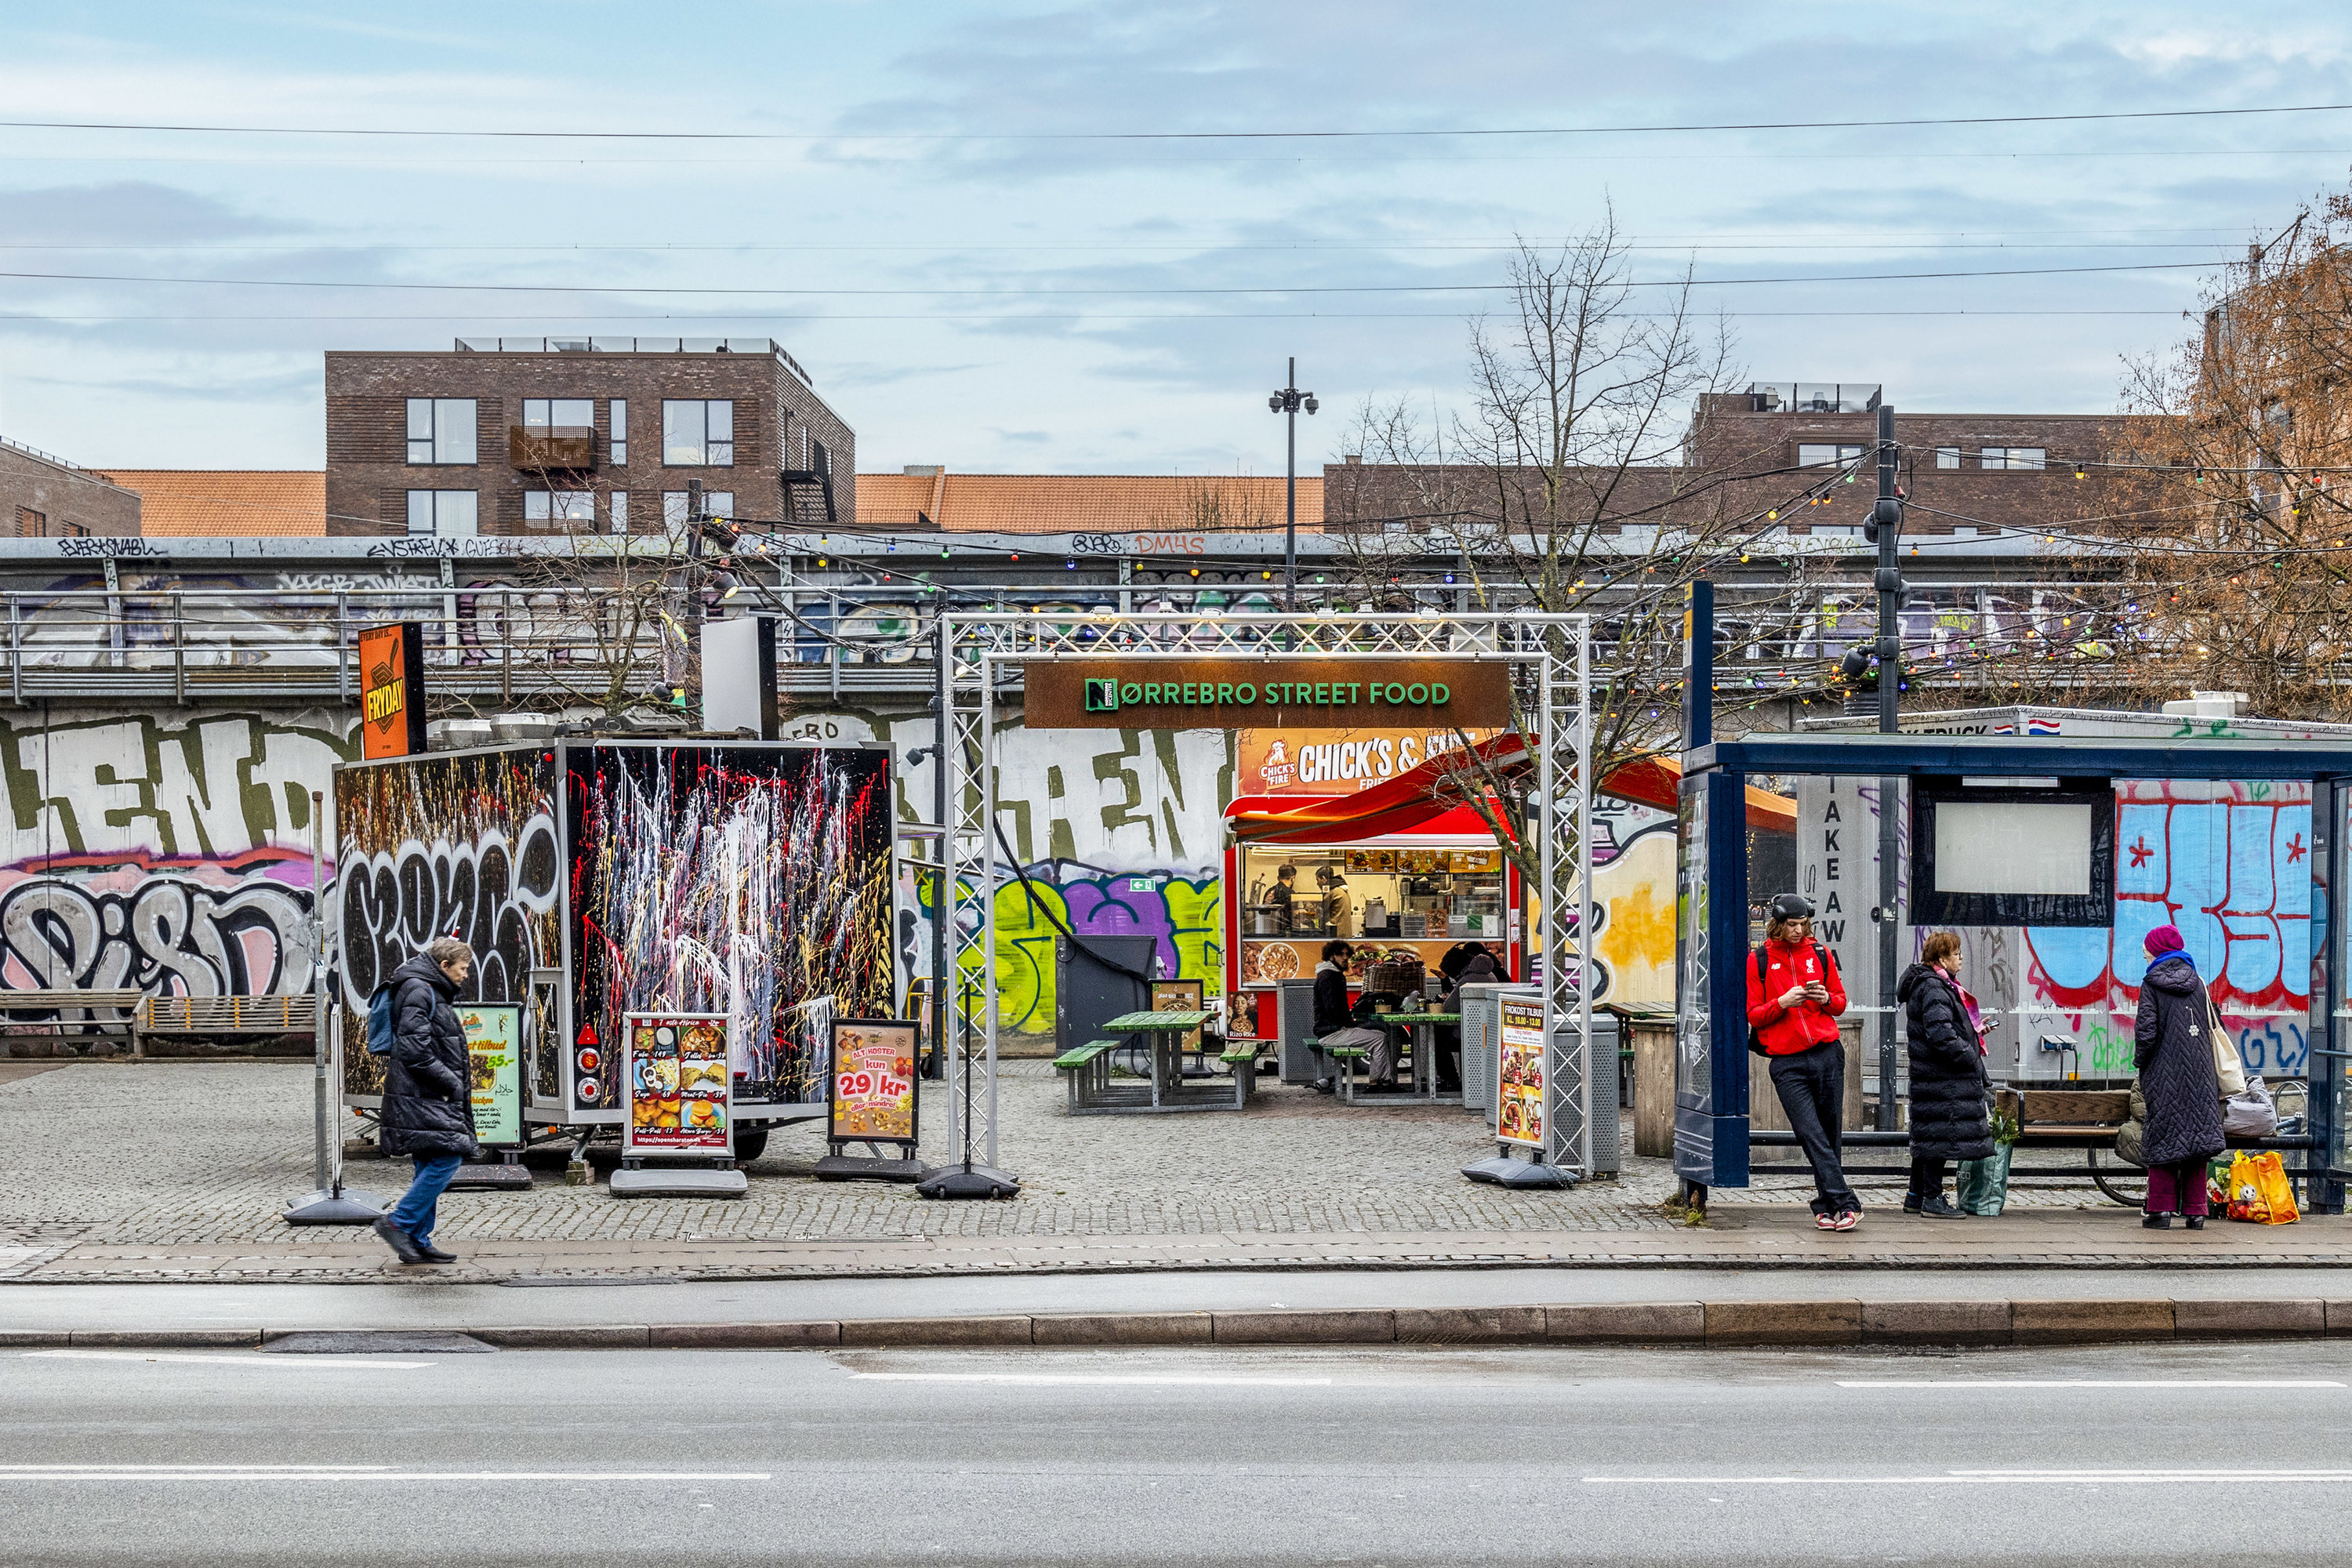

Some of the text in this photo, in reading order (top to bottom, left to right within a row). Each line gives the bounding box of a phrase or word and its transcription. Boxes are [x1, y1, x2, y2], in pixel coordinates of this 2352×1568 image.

[1265, 682, 1362, 704] STREET
[1370, 682, 1450, 705] FOOD
[367, 678, 404, 723] FRYDAY
[1298, 738, 1392, 783] CHICK'S
[1397, 736, 1419, 773] &
[1260, 763, 1295, 778] CHICK'S
[1269, 773, 1290, 786] FIRE
[1505, 1005, 1544, 1018] FROKOST TILBUD
[477, 1039, 507, 1051] tilbud
[853, 1047, 895, 1059] ALT KOSTER
[866, 1059, 886, 1069] kun
[840, 1073, 907, 1097] 29 kr
[470, 1097, 494, 1106] hicken
[851, 1100, 897, 1112] eller mindre!
